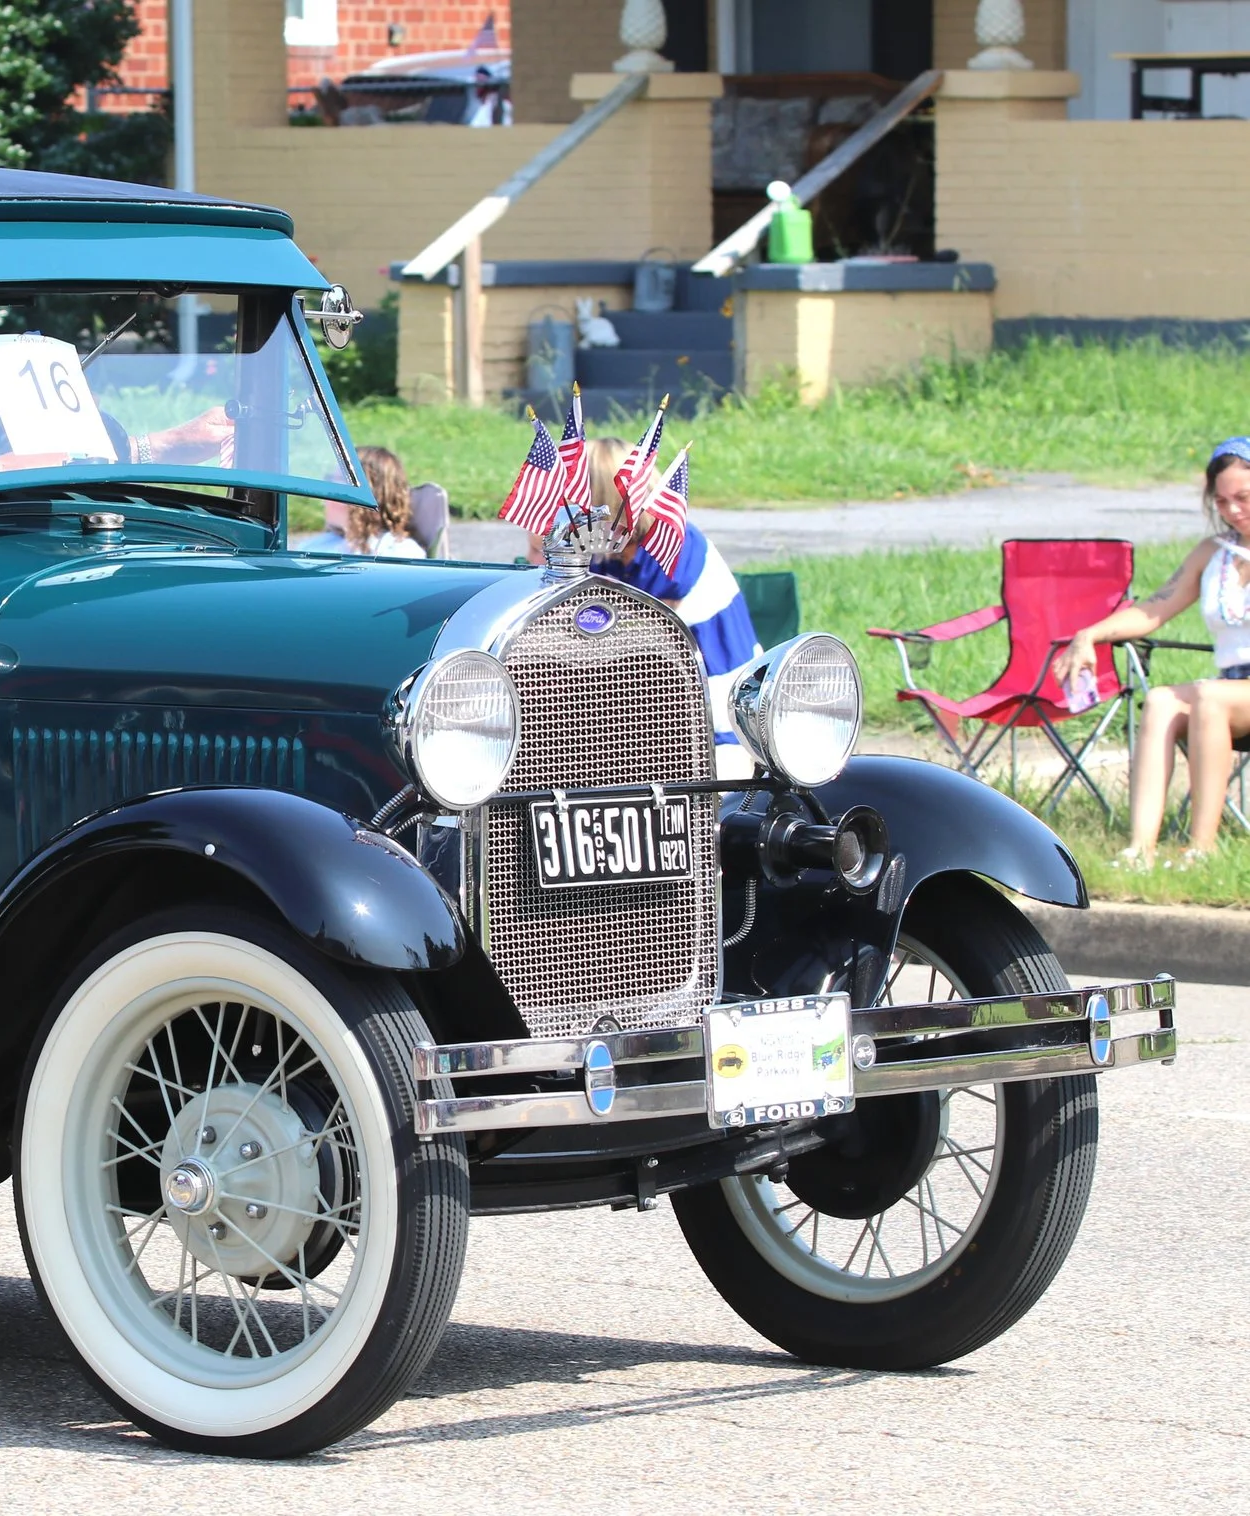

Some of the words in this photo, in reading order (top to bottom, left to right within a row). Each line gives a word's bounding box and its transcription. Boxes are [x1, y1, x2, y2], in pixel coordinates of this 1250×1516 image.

[18, 359, 81, 413] 16
[578, 608, 605, 628] Ford
[592, 808, 606, 874] FRONT
[603, 807, 657, 874] 501
[659, 804, 685, 836] TENN
[539, 808, 597, 877] 316
[659, 840, 688, 871] 1928
[753, 1101, 816, 1122] FORD
